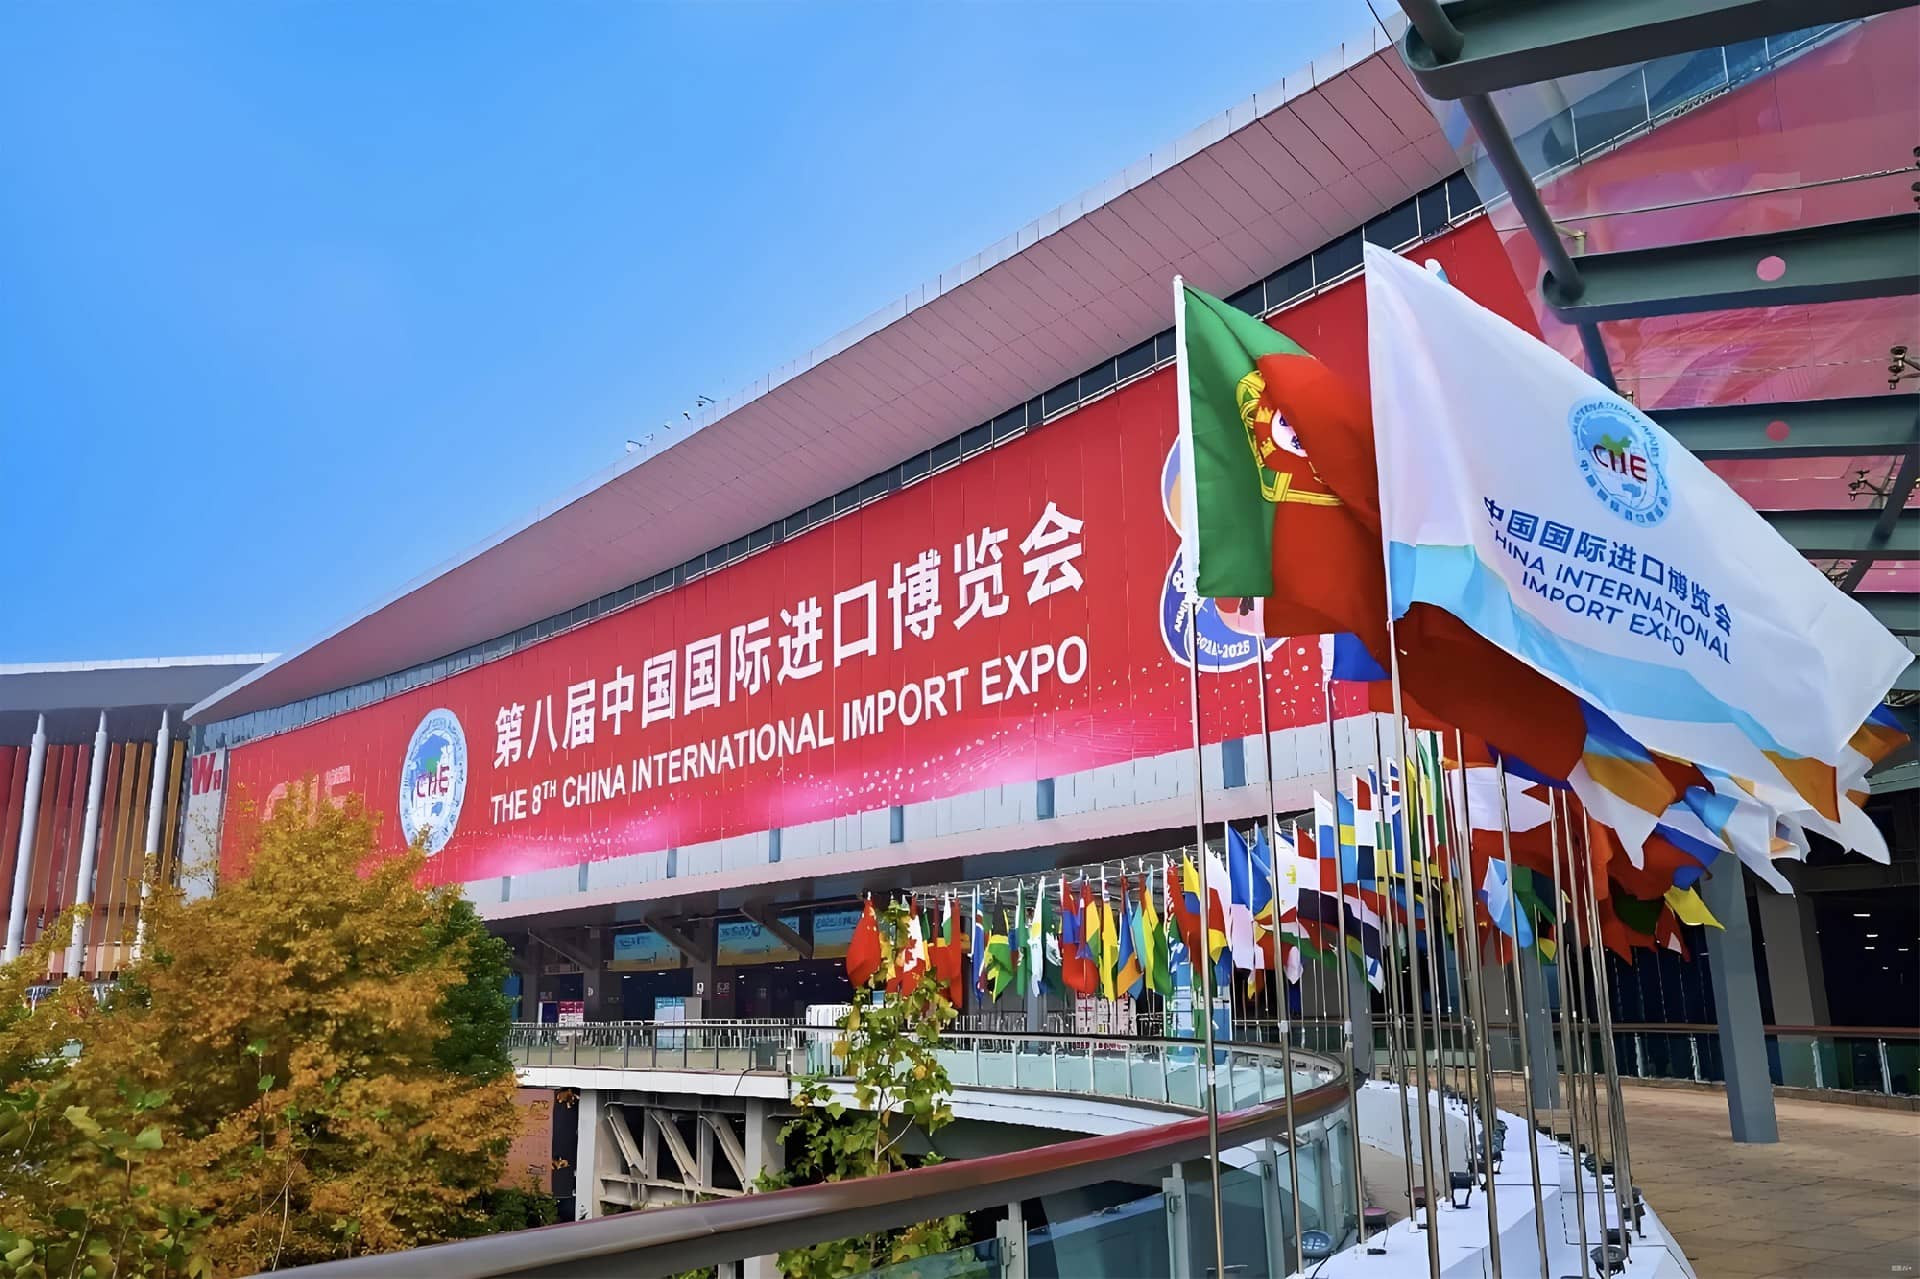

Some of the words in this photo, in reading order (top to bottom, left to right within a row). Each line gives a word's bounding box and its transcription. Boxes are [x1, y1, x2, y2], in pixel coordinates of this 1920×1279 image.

[494, 501, 1084, 769] 第八届中国国际进口博览会
[1484, 497, 1732, 637] 中国国际进口博览会
[1489, 521, 1545, 576] HINA
[1556, 563, 1732, 664] INTERNATIONAL
[1522, 571, 1624, 625] IMPORT
[1629, 613, 1685, 657] EXPO
[491, 789, 527, 825] THE
[532, 779, 557, 815] 8TH
[563, 765, 626, 808] CHINA
[632, 709, 834, 793] INTERNATIONAL
[843, 667, 969, 742] IMPORT
[982, 636, 1088, 705] EXPO
